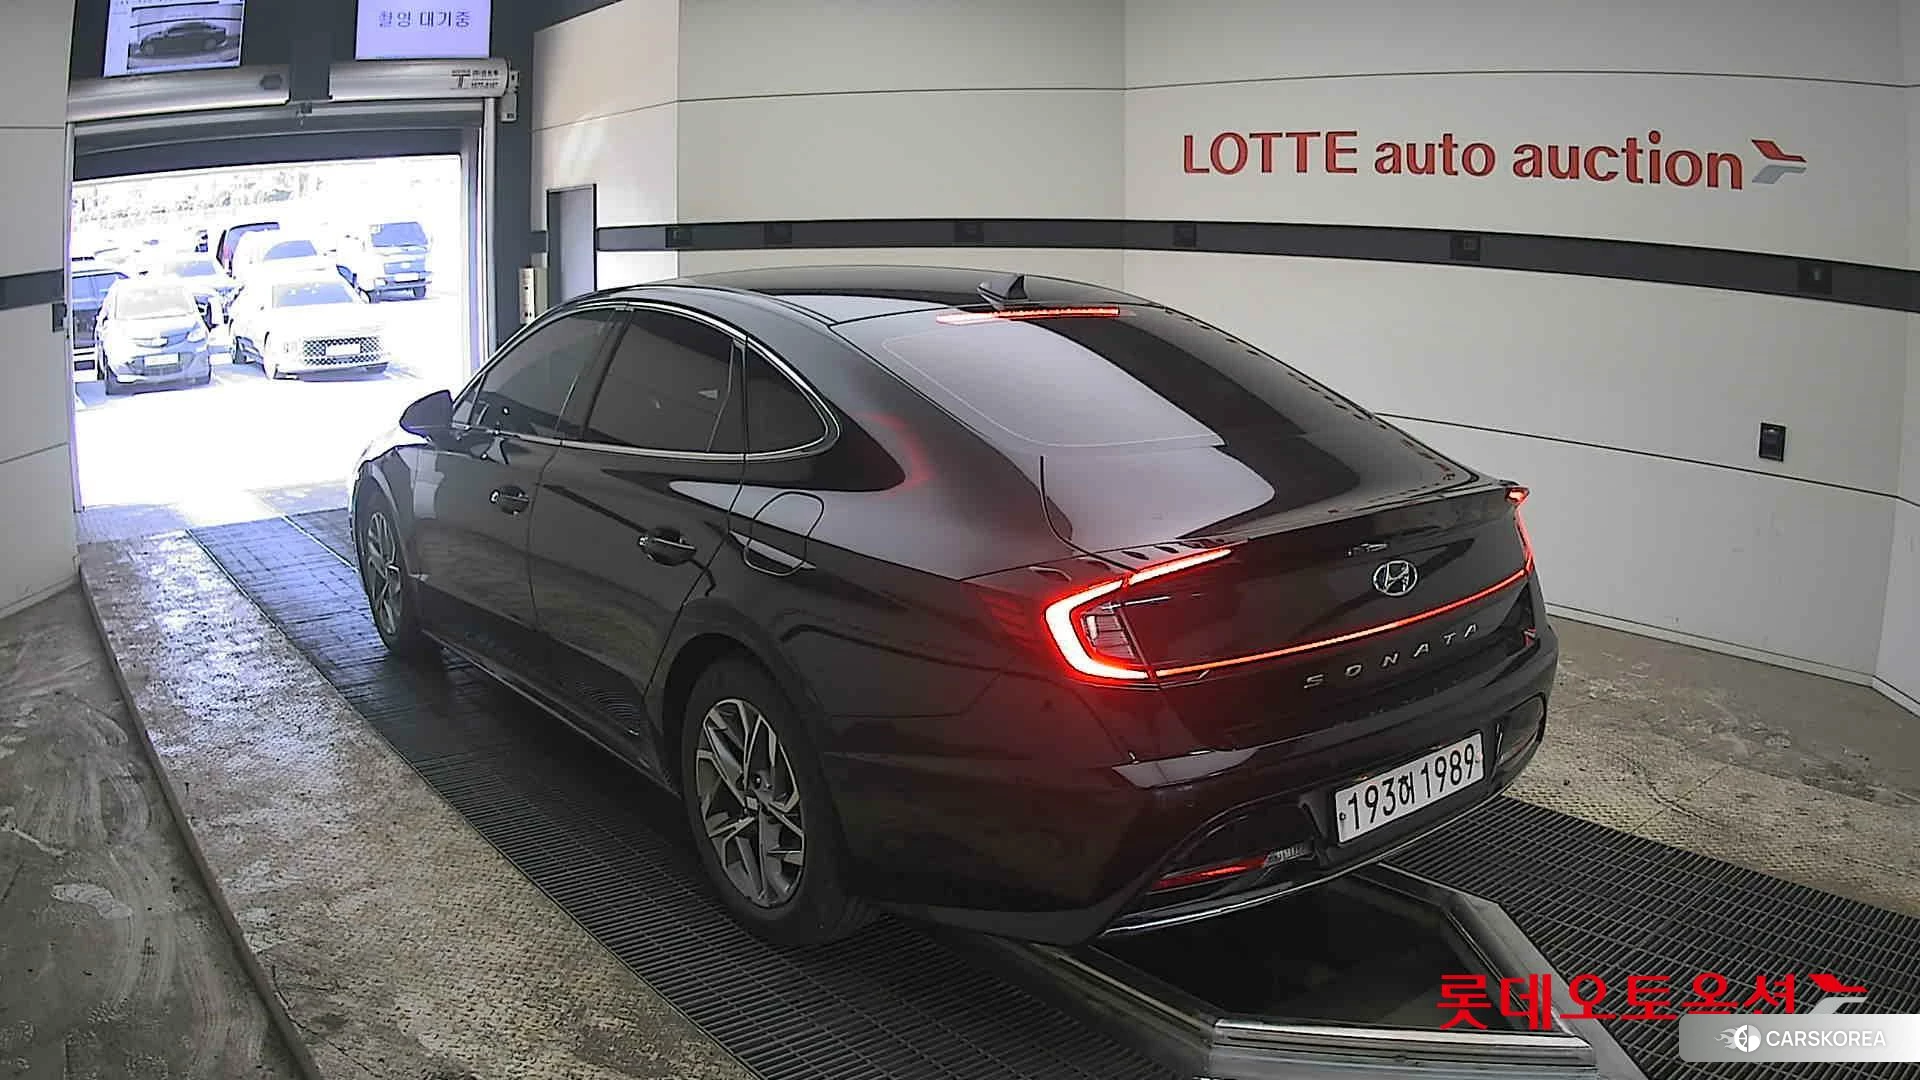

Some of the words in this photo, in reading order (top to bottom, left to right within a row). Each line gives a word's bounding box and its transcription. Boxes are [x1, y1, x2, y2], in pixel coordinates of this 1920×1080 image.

[1183, 130, 1358, 175] LOTTE
[1374, 133, 1496, 177] auto
[1512, 130, 1743, 190] auction
[1303, 623, 1478, 689] SONATA
[1420, 743, 1475, 799] 1989
